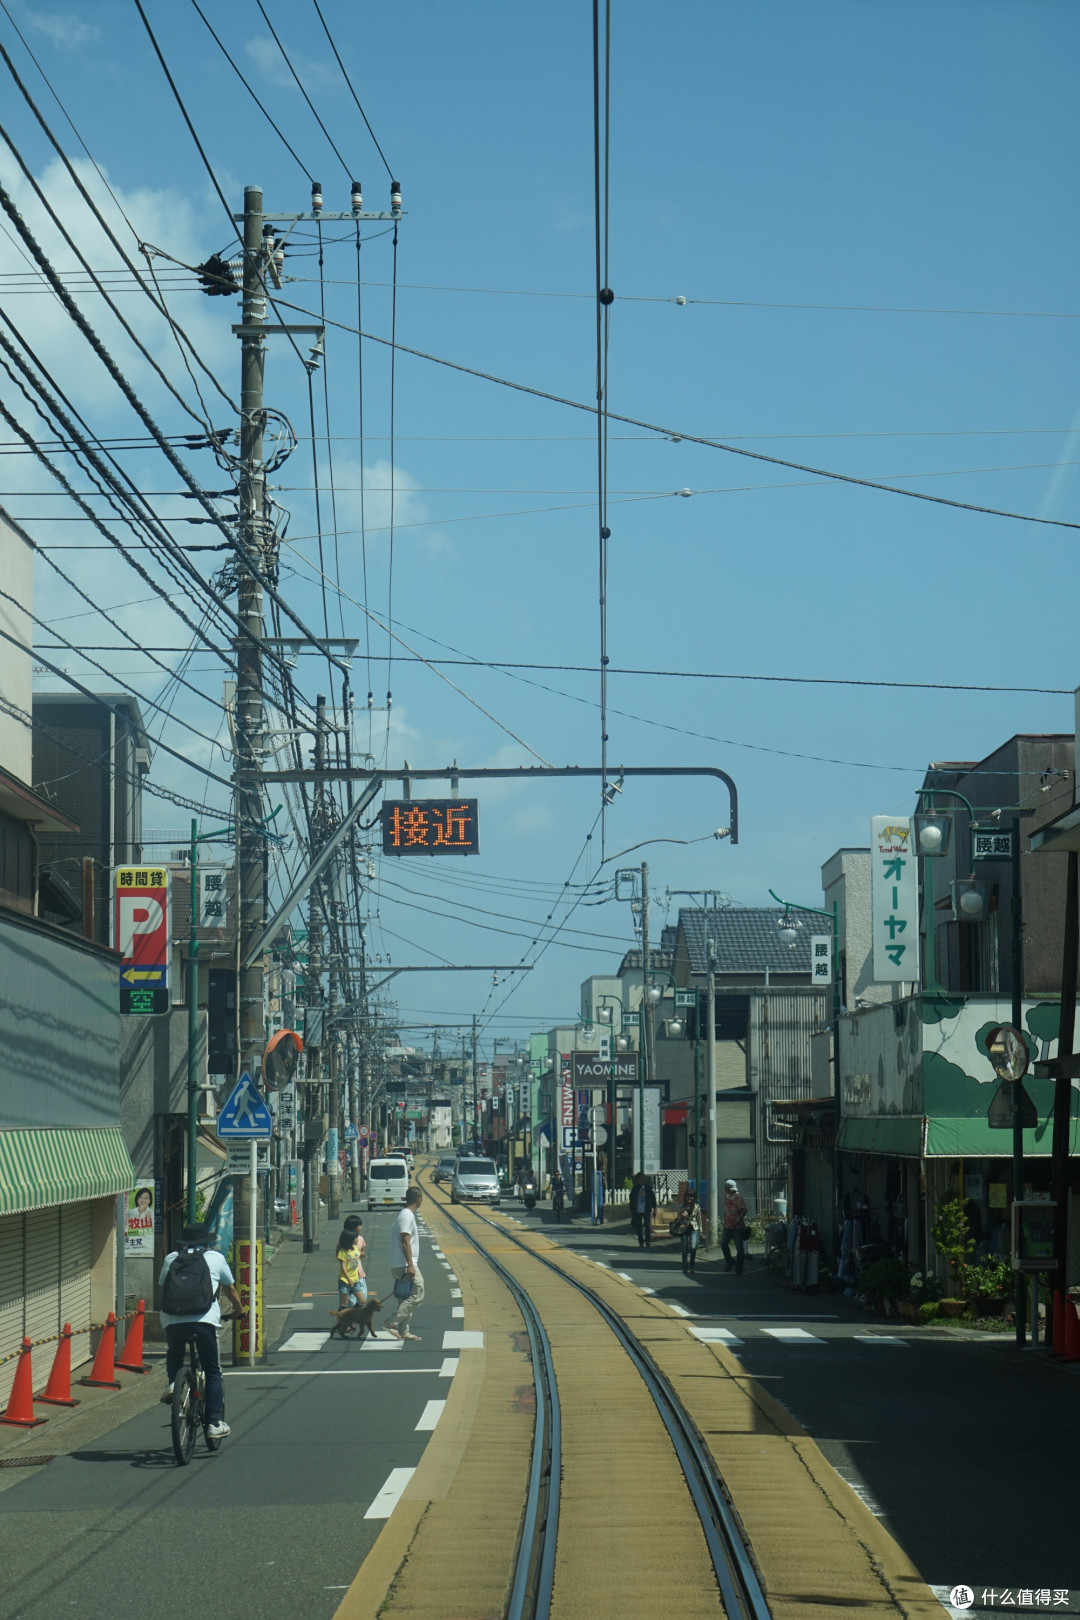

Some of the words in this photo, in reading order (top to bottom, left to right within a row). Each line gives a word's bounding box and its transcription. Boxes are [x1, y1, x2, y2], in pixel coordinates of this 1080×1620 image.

[389, 806, 472, 846] 接近
[976, 837, 1010, 853] 腰越
[120, 872, 163, 886] 時間貸
[204, 875, 222, 917] 腰越
[883, 857, 907, 966] オーヤマ
[119, 896, 163, 959] P
[815, 943, 828, 976] 腰越
[130, 988, 154, 1012] 空
[576, 1064, 636, 1076] YAOMINE
[128, 1216, 152, 1230] 牧山
